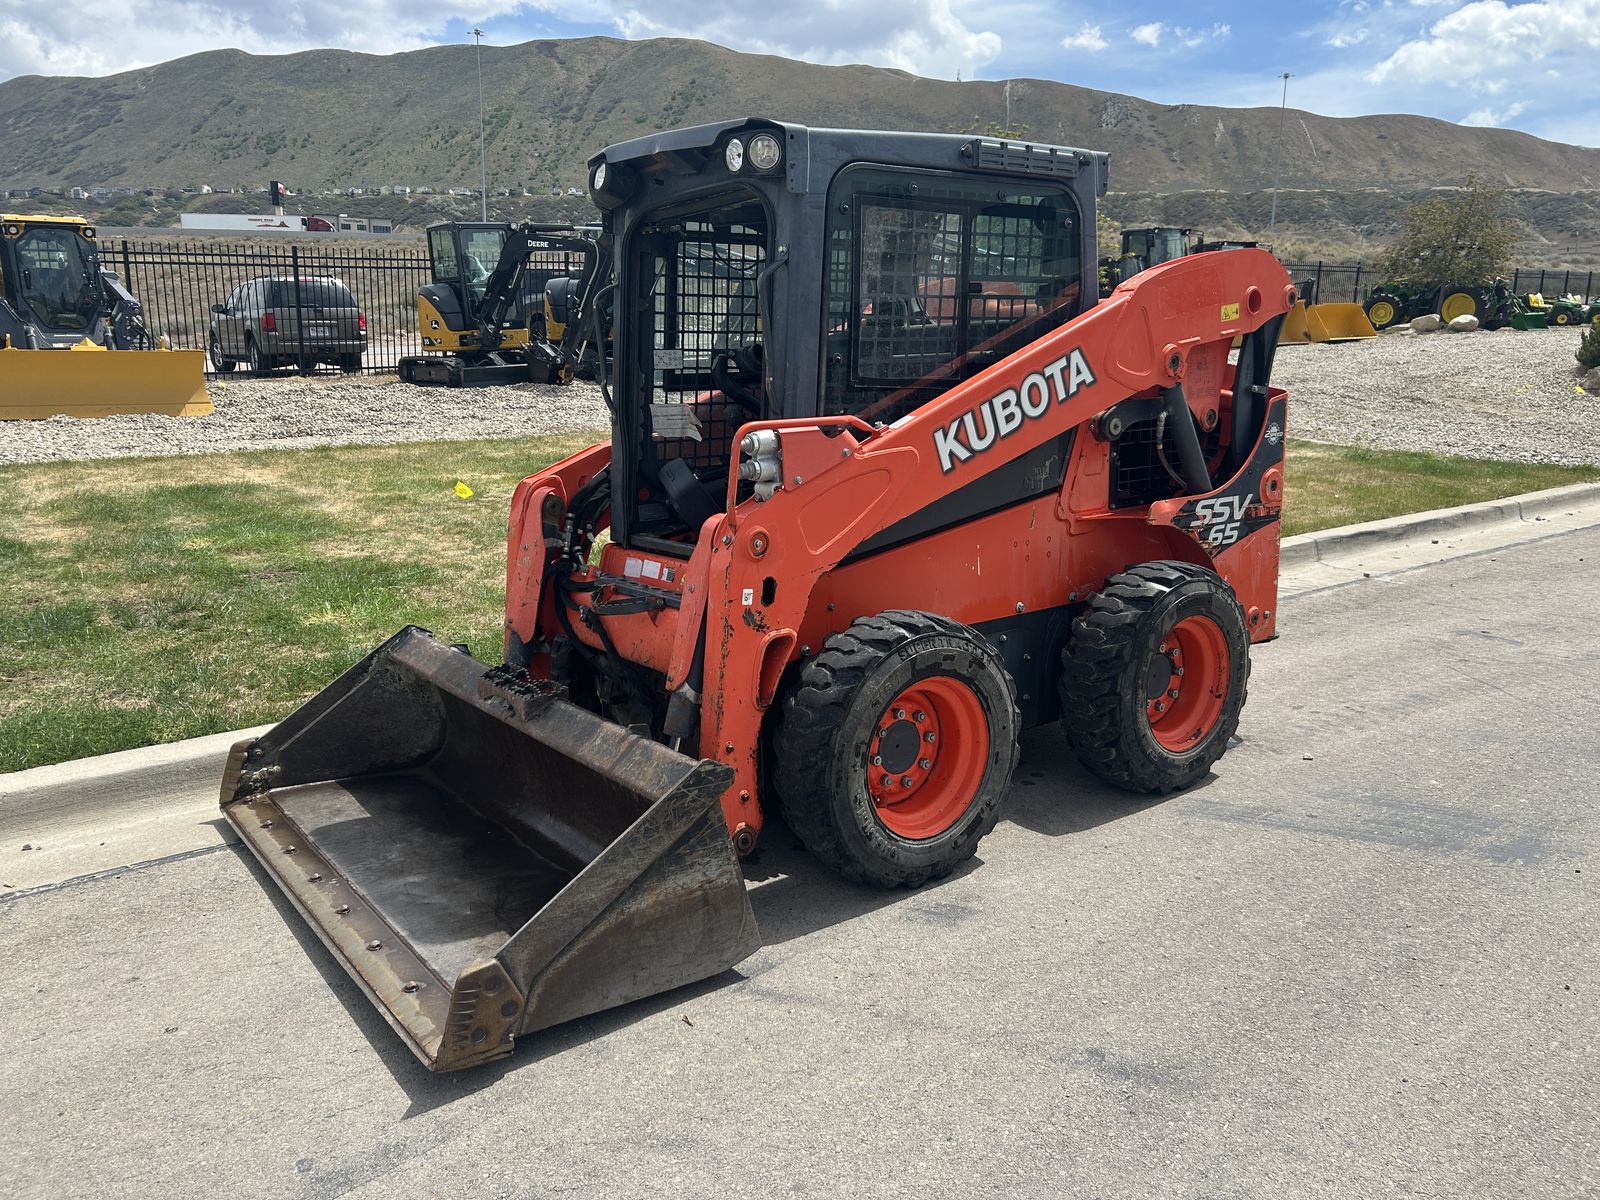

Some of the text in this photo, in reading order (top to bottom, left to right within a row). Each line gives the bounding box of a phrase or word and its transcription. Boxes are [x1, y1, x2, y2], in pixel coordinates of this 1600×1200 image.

[527, 239, 549, 248] DEERE
[933, 348, 1095, 473] KUBOTA
[1190, 494, 1253, 527] SSV
[1208, 522, 1241, 546] 65
